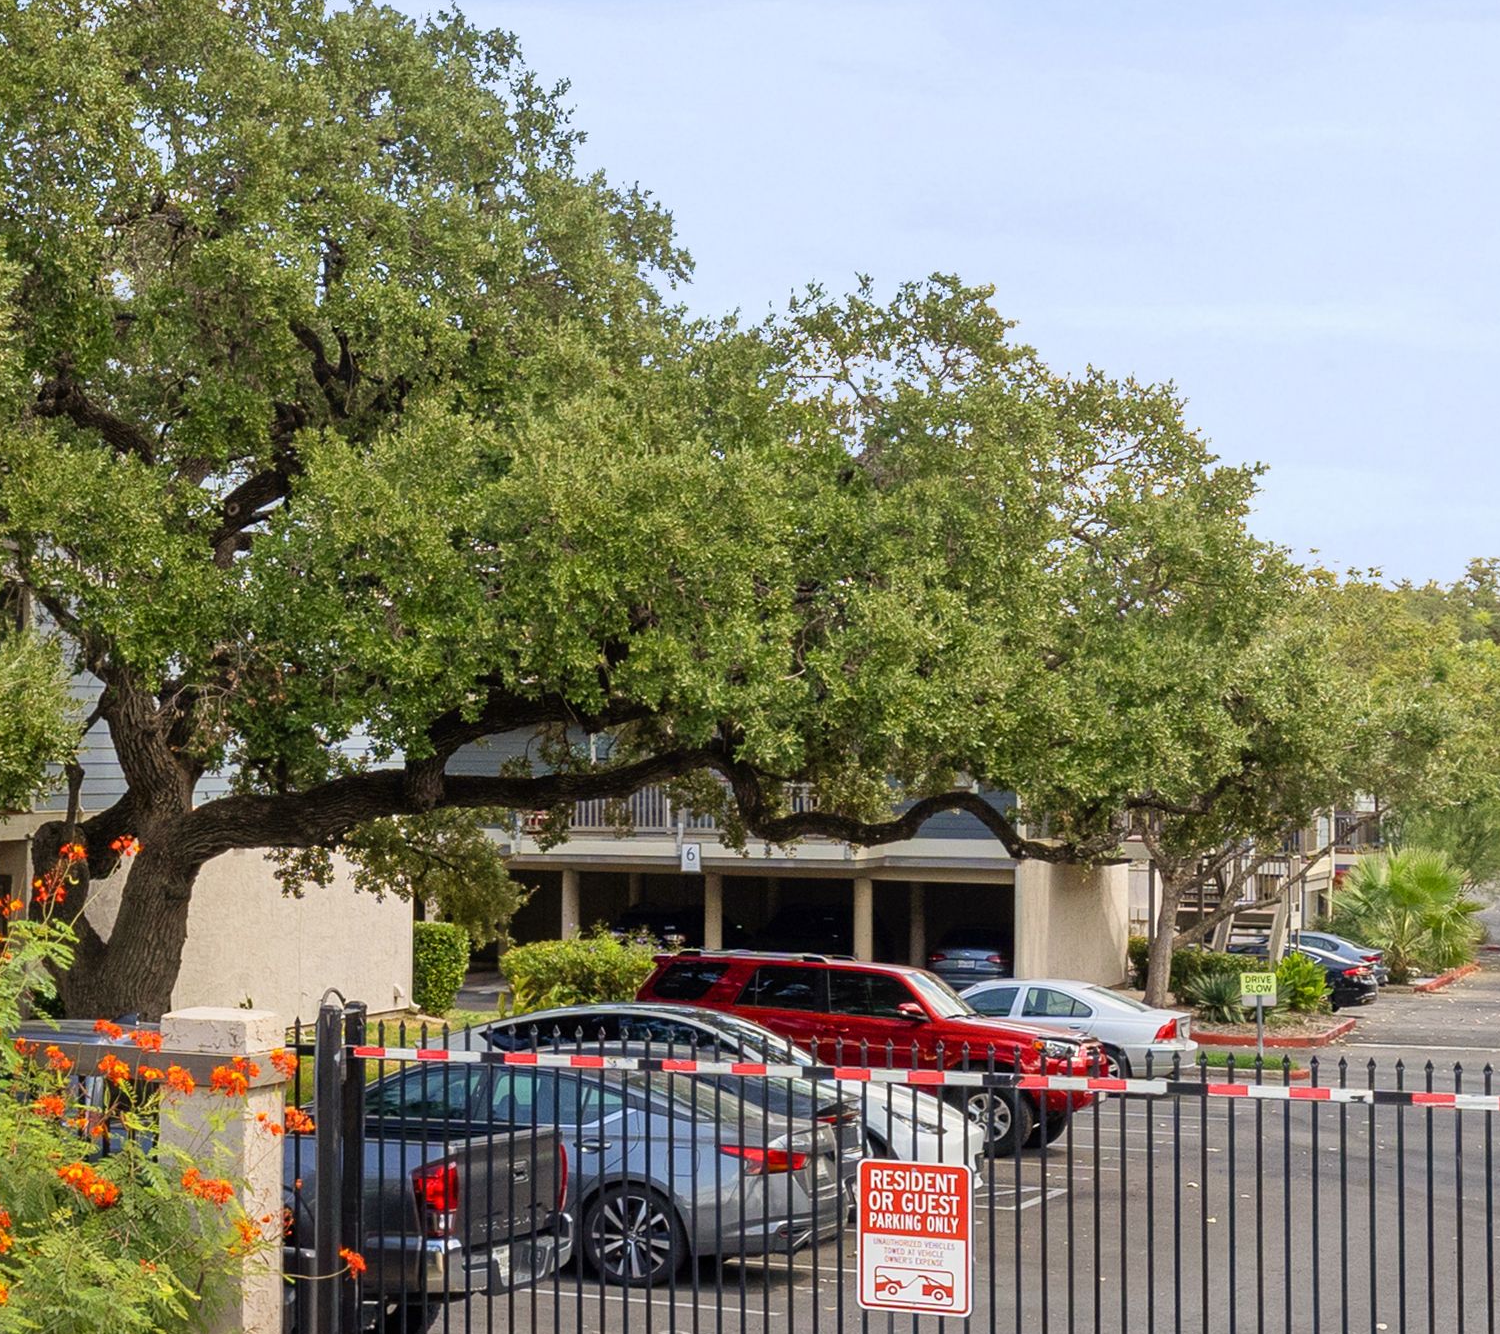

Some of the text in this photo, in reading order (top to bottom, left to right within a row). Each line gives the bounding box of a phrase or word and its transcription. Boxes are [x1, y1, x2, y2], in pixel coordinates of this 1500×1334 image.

[686, 846, 695, 861] 6
[1245, 975, 1272, 983] DRIVE
[1245, 984, 1272, 993] SLOW
[870, 1169, 958, 1194] RESIDENT
[868, 1191, 960, 1216] OR GUEST
[869, 1212, 959, 1234] PARKING ONLY
[873, 1237, 955, 1251] UNAUTHORIZED VEHICLES
[884, 1247, 905, 1255] TOWED
[917, 1250, 944, 1258] VEHICLE
[884, 1255, 944, 1267] OWNER'S EXPENSE
